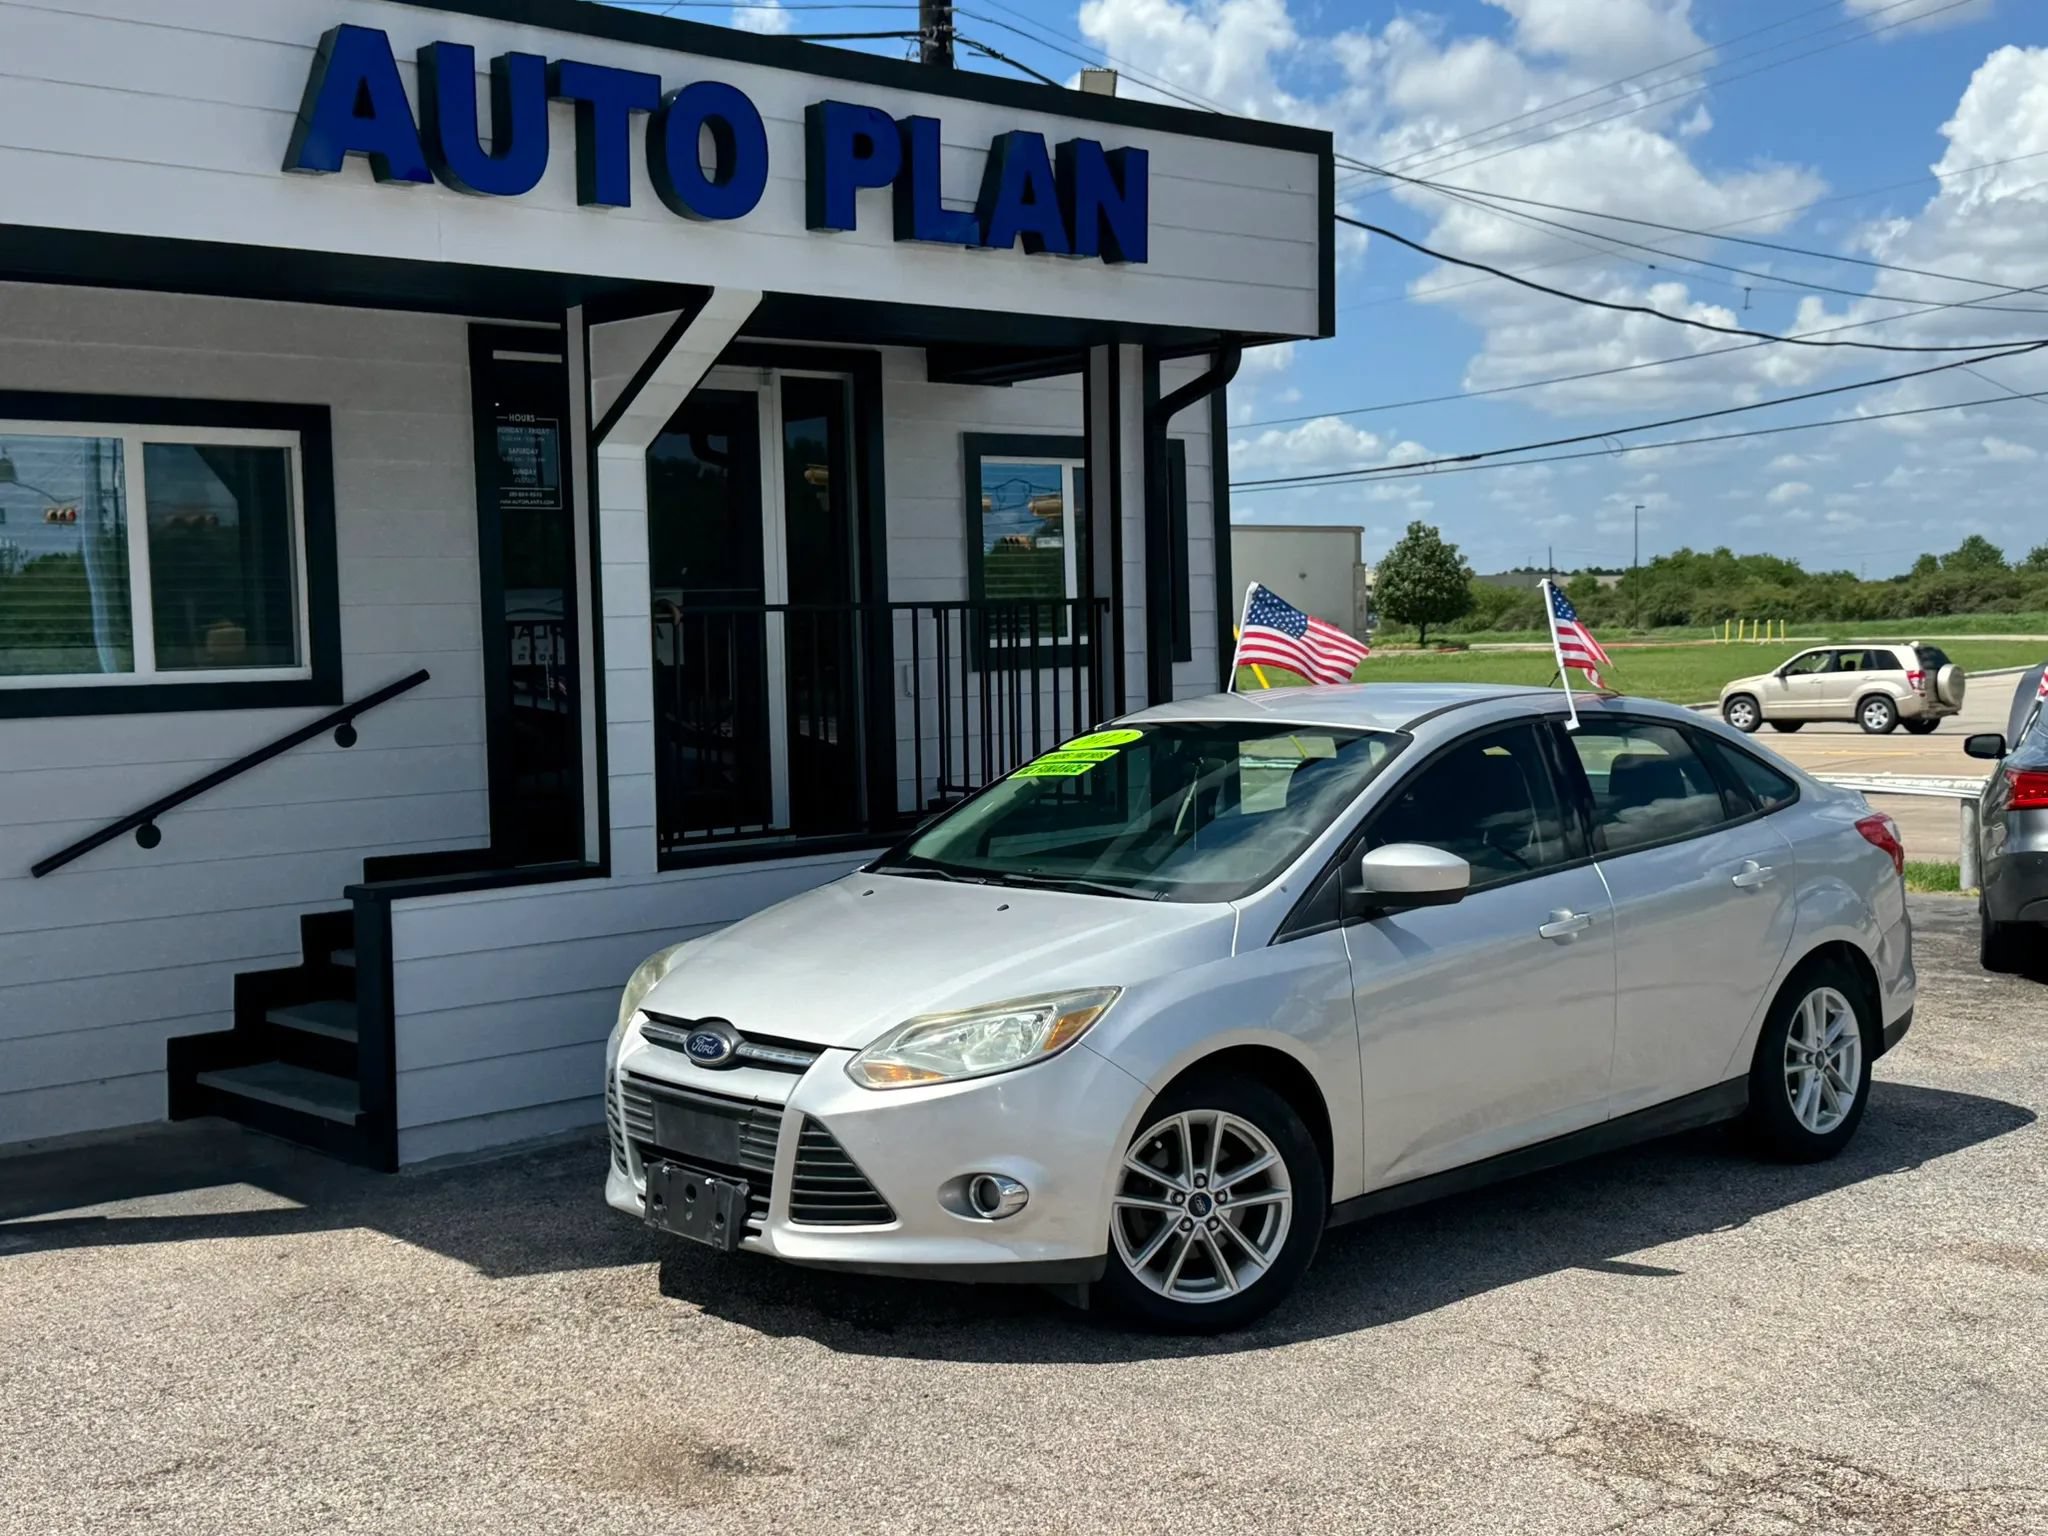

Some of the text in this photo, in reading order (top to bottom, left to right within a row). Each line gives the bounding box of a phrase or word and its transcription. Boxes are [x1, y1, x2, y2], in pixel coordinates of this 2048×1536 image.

[282, 23, 1149, 264] AUTO PLAN
[508, 413, 536, 423] HOURS
[691, 1035, 718, 1056] Ford
